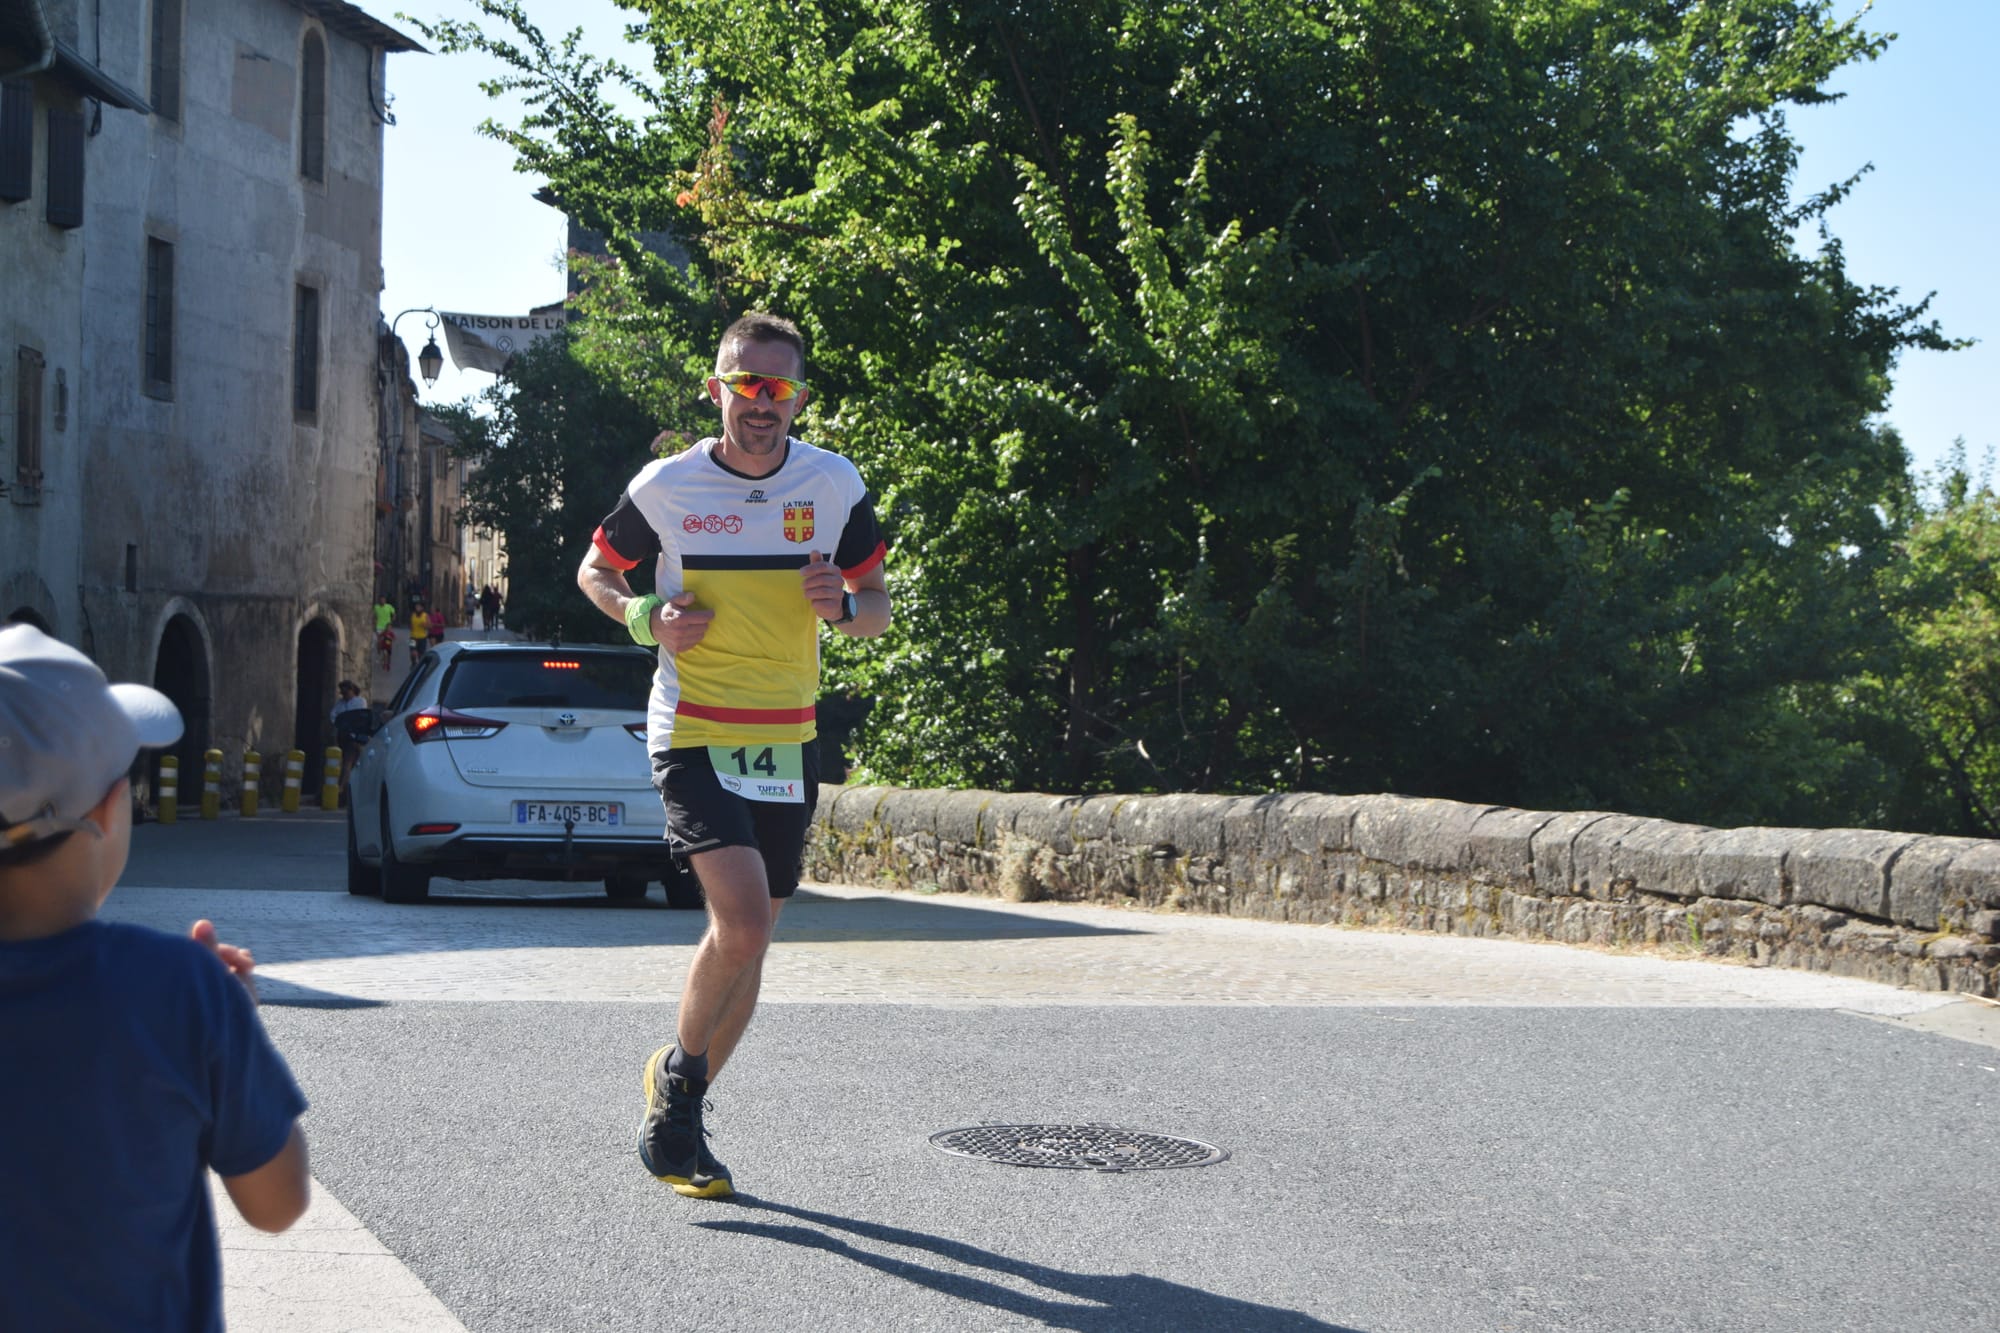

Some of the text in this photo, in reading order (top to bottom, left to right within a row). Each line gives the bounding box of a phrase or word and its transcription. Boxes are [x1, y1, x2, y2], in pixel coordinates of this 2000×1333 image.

[443, 316, 513, 329] MAISON
[518, 317, 540, 330] DE
[794, 500, 814, 508] TEAM
[731, 747, 777, 776] 14
[528, 804, 607, 823] FA-405-BC
